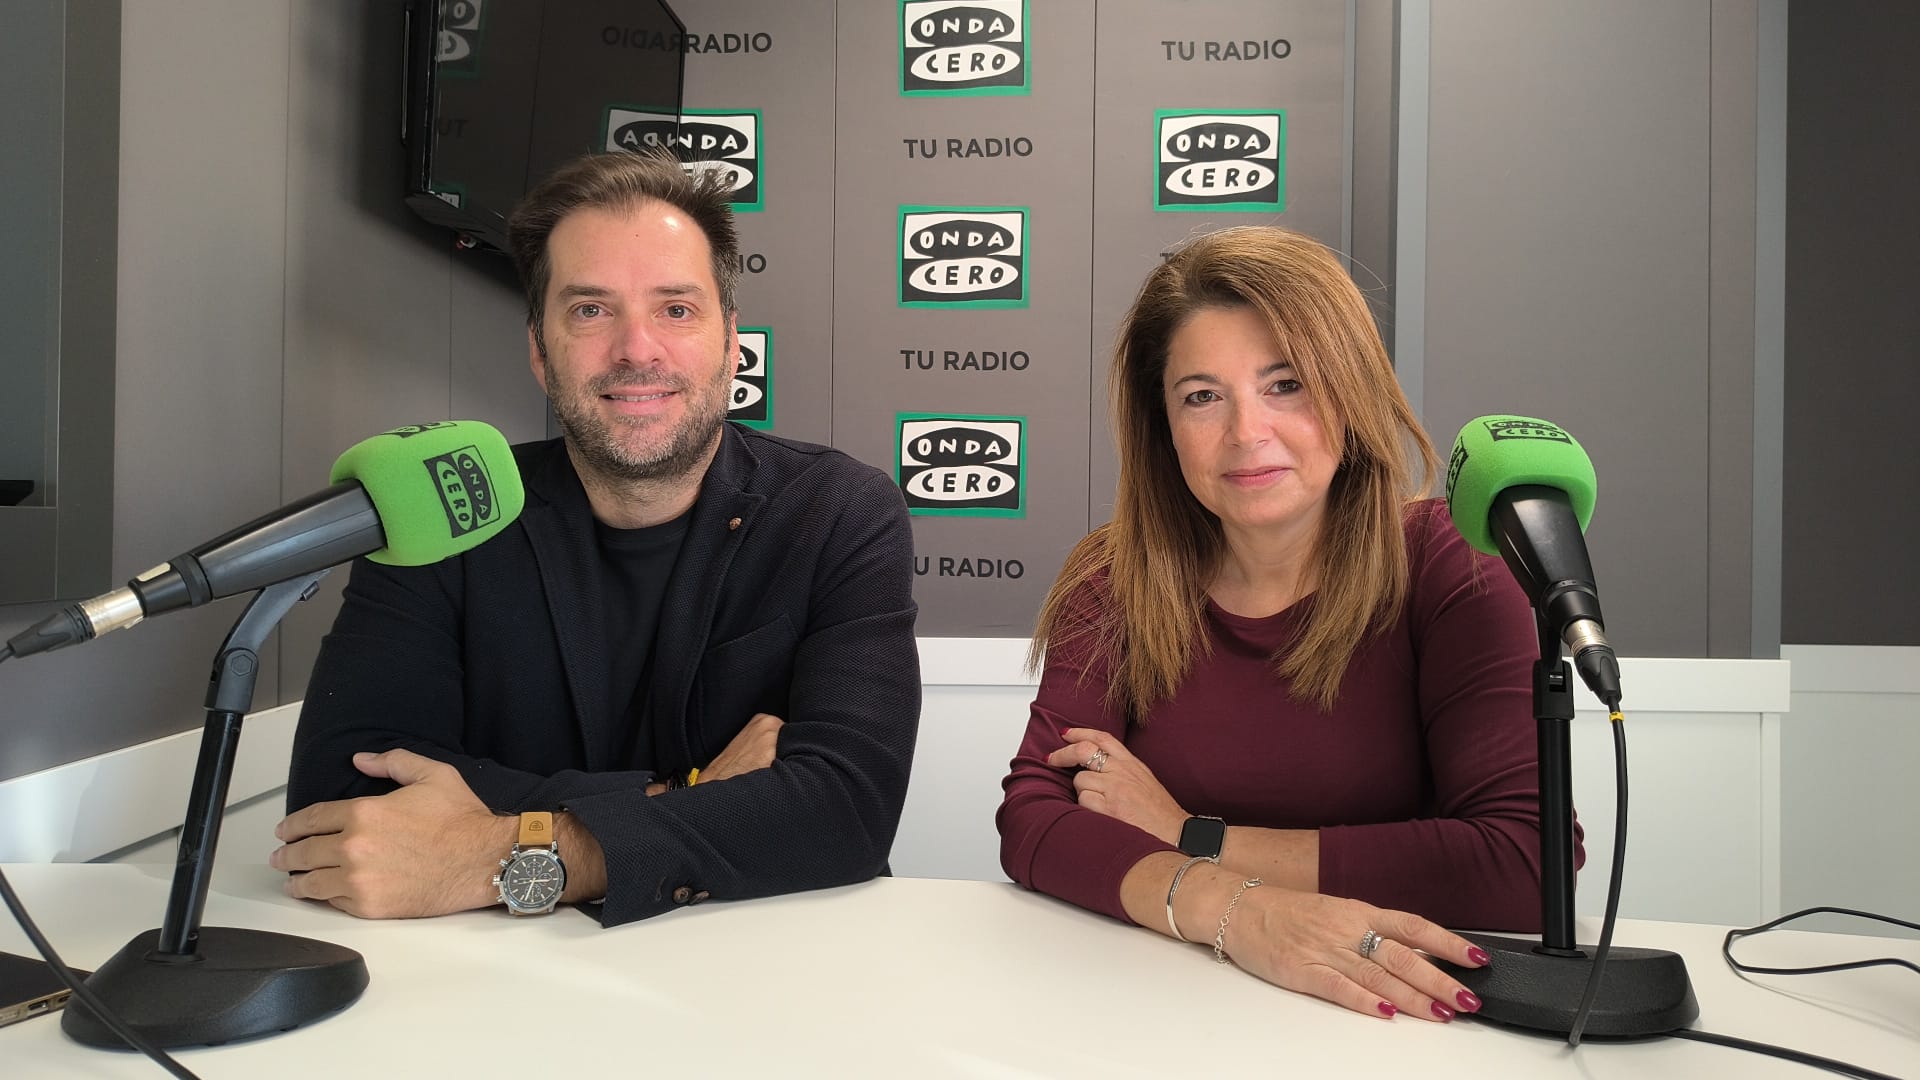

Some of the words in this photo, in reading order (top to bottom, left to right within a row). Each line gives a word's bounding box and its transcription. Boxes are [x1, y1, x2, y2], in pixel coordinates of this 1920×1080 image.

[920, 17, 1006, 37] ONDA
[685, 32, 772, 54] RADIO
[1161, 40, 1195, 62] TU
[1204, 39, 1292, 62] RADIO
[925, 52, 1006, 74] CERO
[903, 138, 937, 158] TU
[946, 137, 1033, 158] RADIO
[1176, 133, 1261, 152] ONDA
[1181, 167, 1261, 189] CERO
[919, 230, 1005, 249] ONDA
[924, 265, 1004, 286] CERO
[900, 350, 934, 370] TU
[944, 350, 1030, 371] RADIO
[918, 438, 1002, 456] ONDA
[462, 459, 488, 514] ONDA
[922, 472, 1001, 493] CERO
[443, 469, 470, 522] CERO
[914, 556, 929, 576] U
[940, 556, 1025, 579] RADIO
